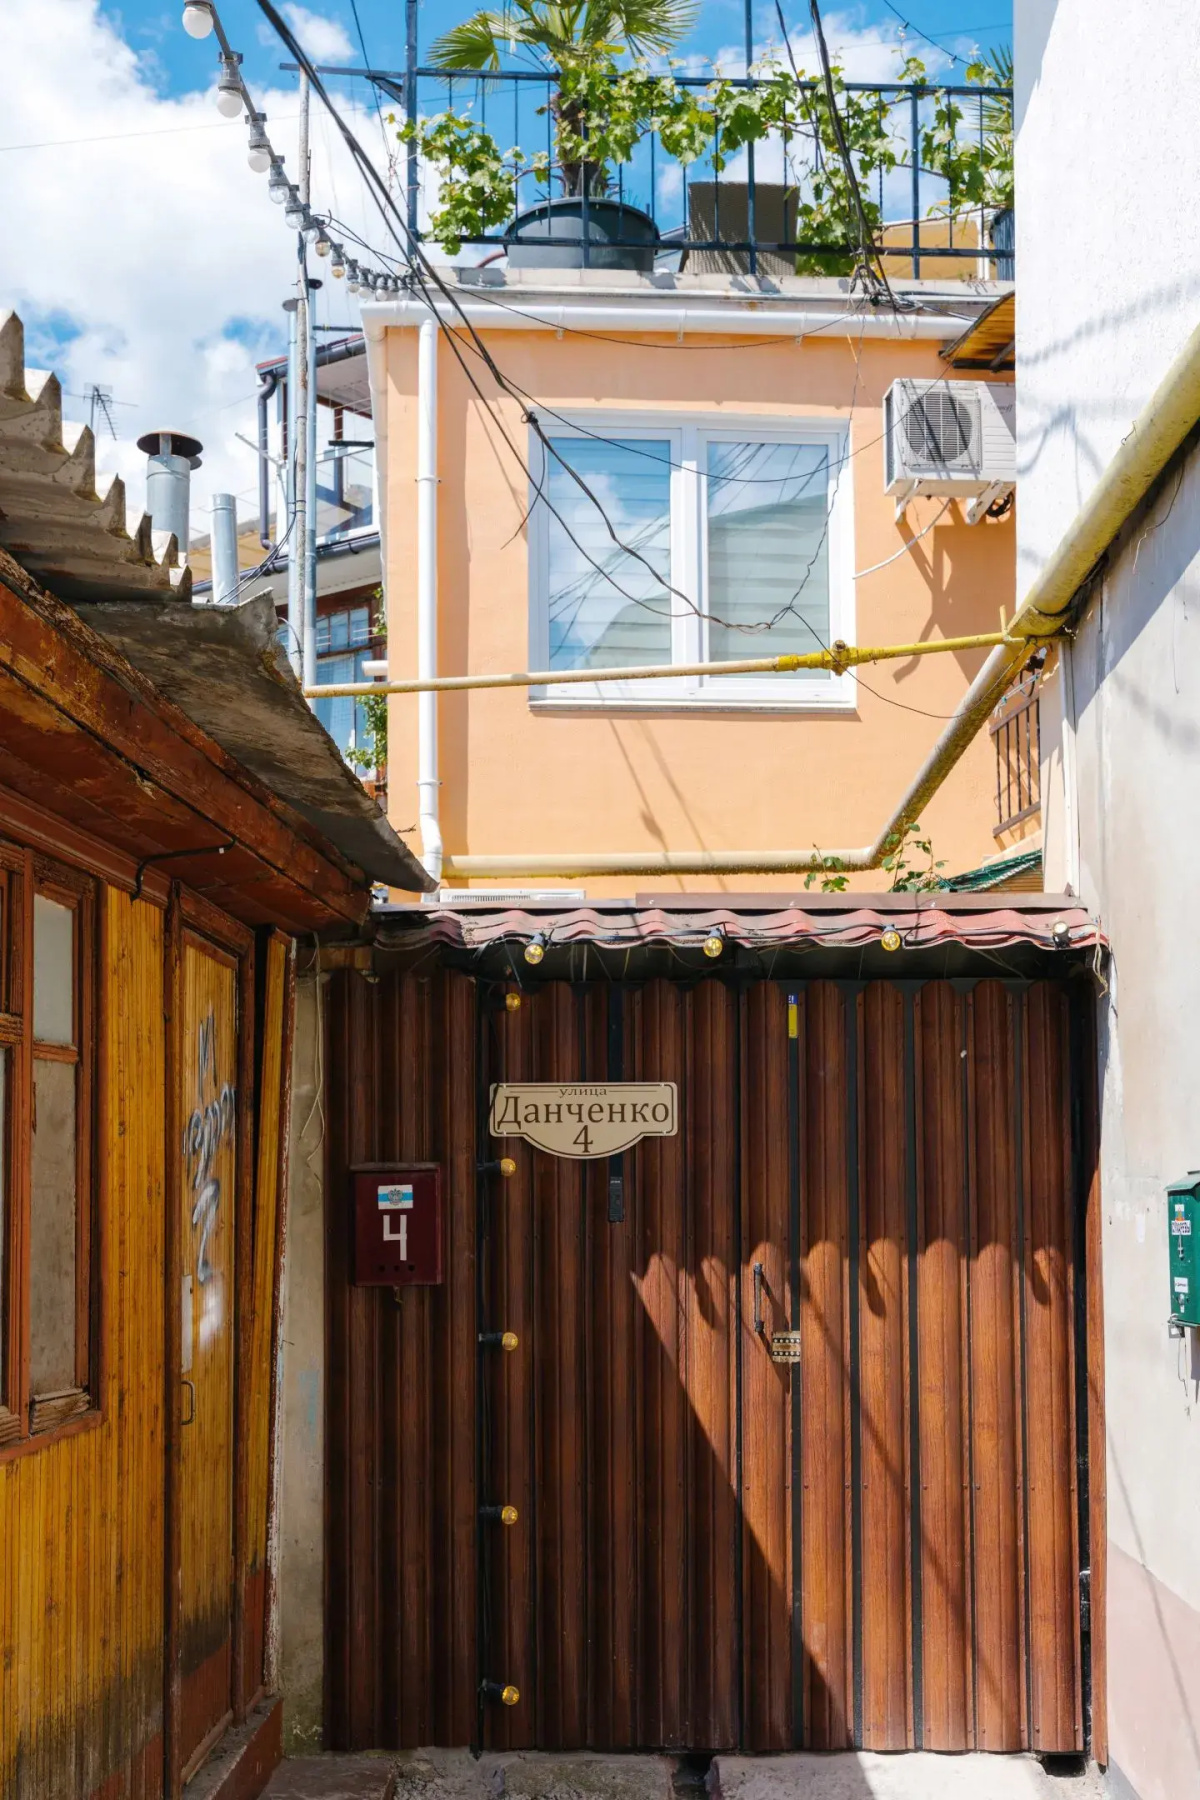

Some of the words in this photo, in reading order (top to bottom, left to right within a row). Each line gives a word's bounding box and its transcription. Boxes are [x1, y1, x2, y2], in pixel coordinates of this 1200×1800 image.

[559, 1088, 607, 1098] улица
[497, 1096, 670, 1130] Данченко
[572, 1125, 593, 1153] 4
[383, 1214, 407, 1261] 4
